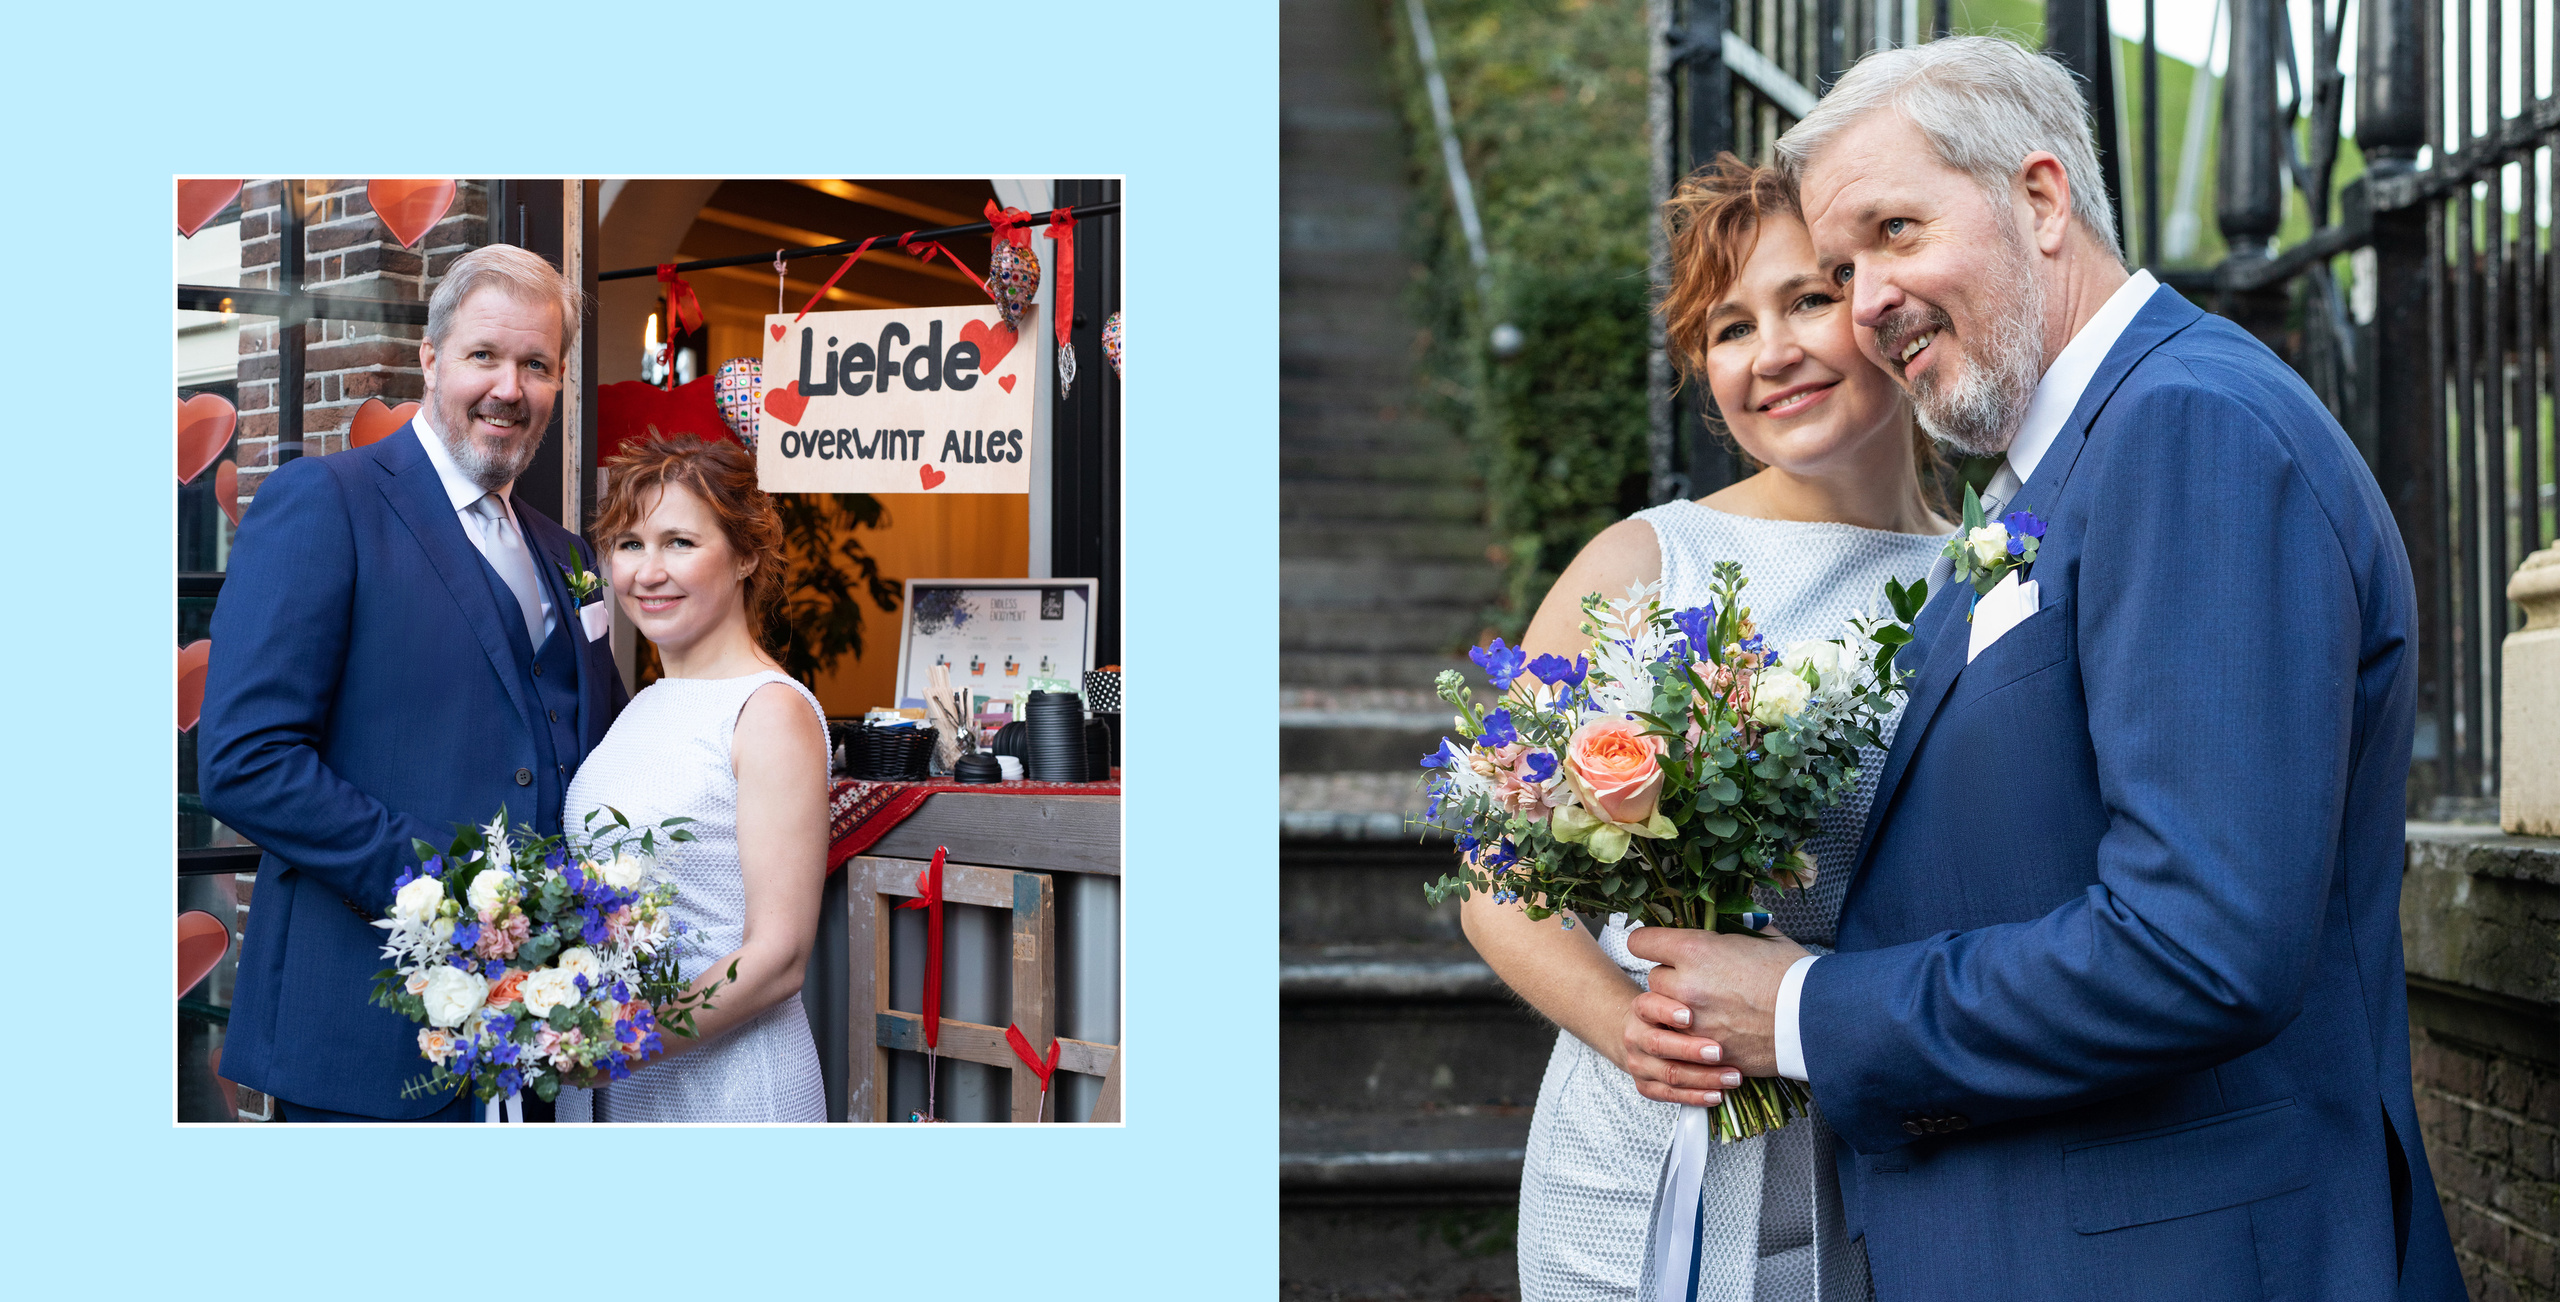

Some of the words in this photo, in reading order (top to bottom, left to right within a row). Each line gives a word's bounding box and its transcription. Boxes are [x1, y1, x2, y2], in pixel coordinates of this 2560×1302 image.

[798, 319, 981, 397] Liefde
[939, 428, 1023, 464] ALLES
[990, 598, 1017, 609] ENDLESS
